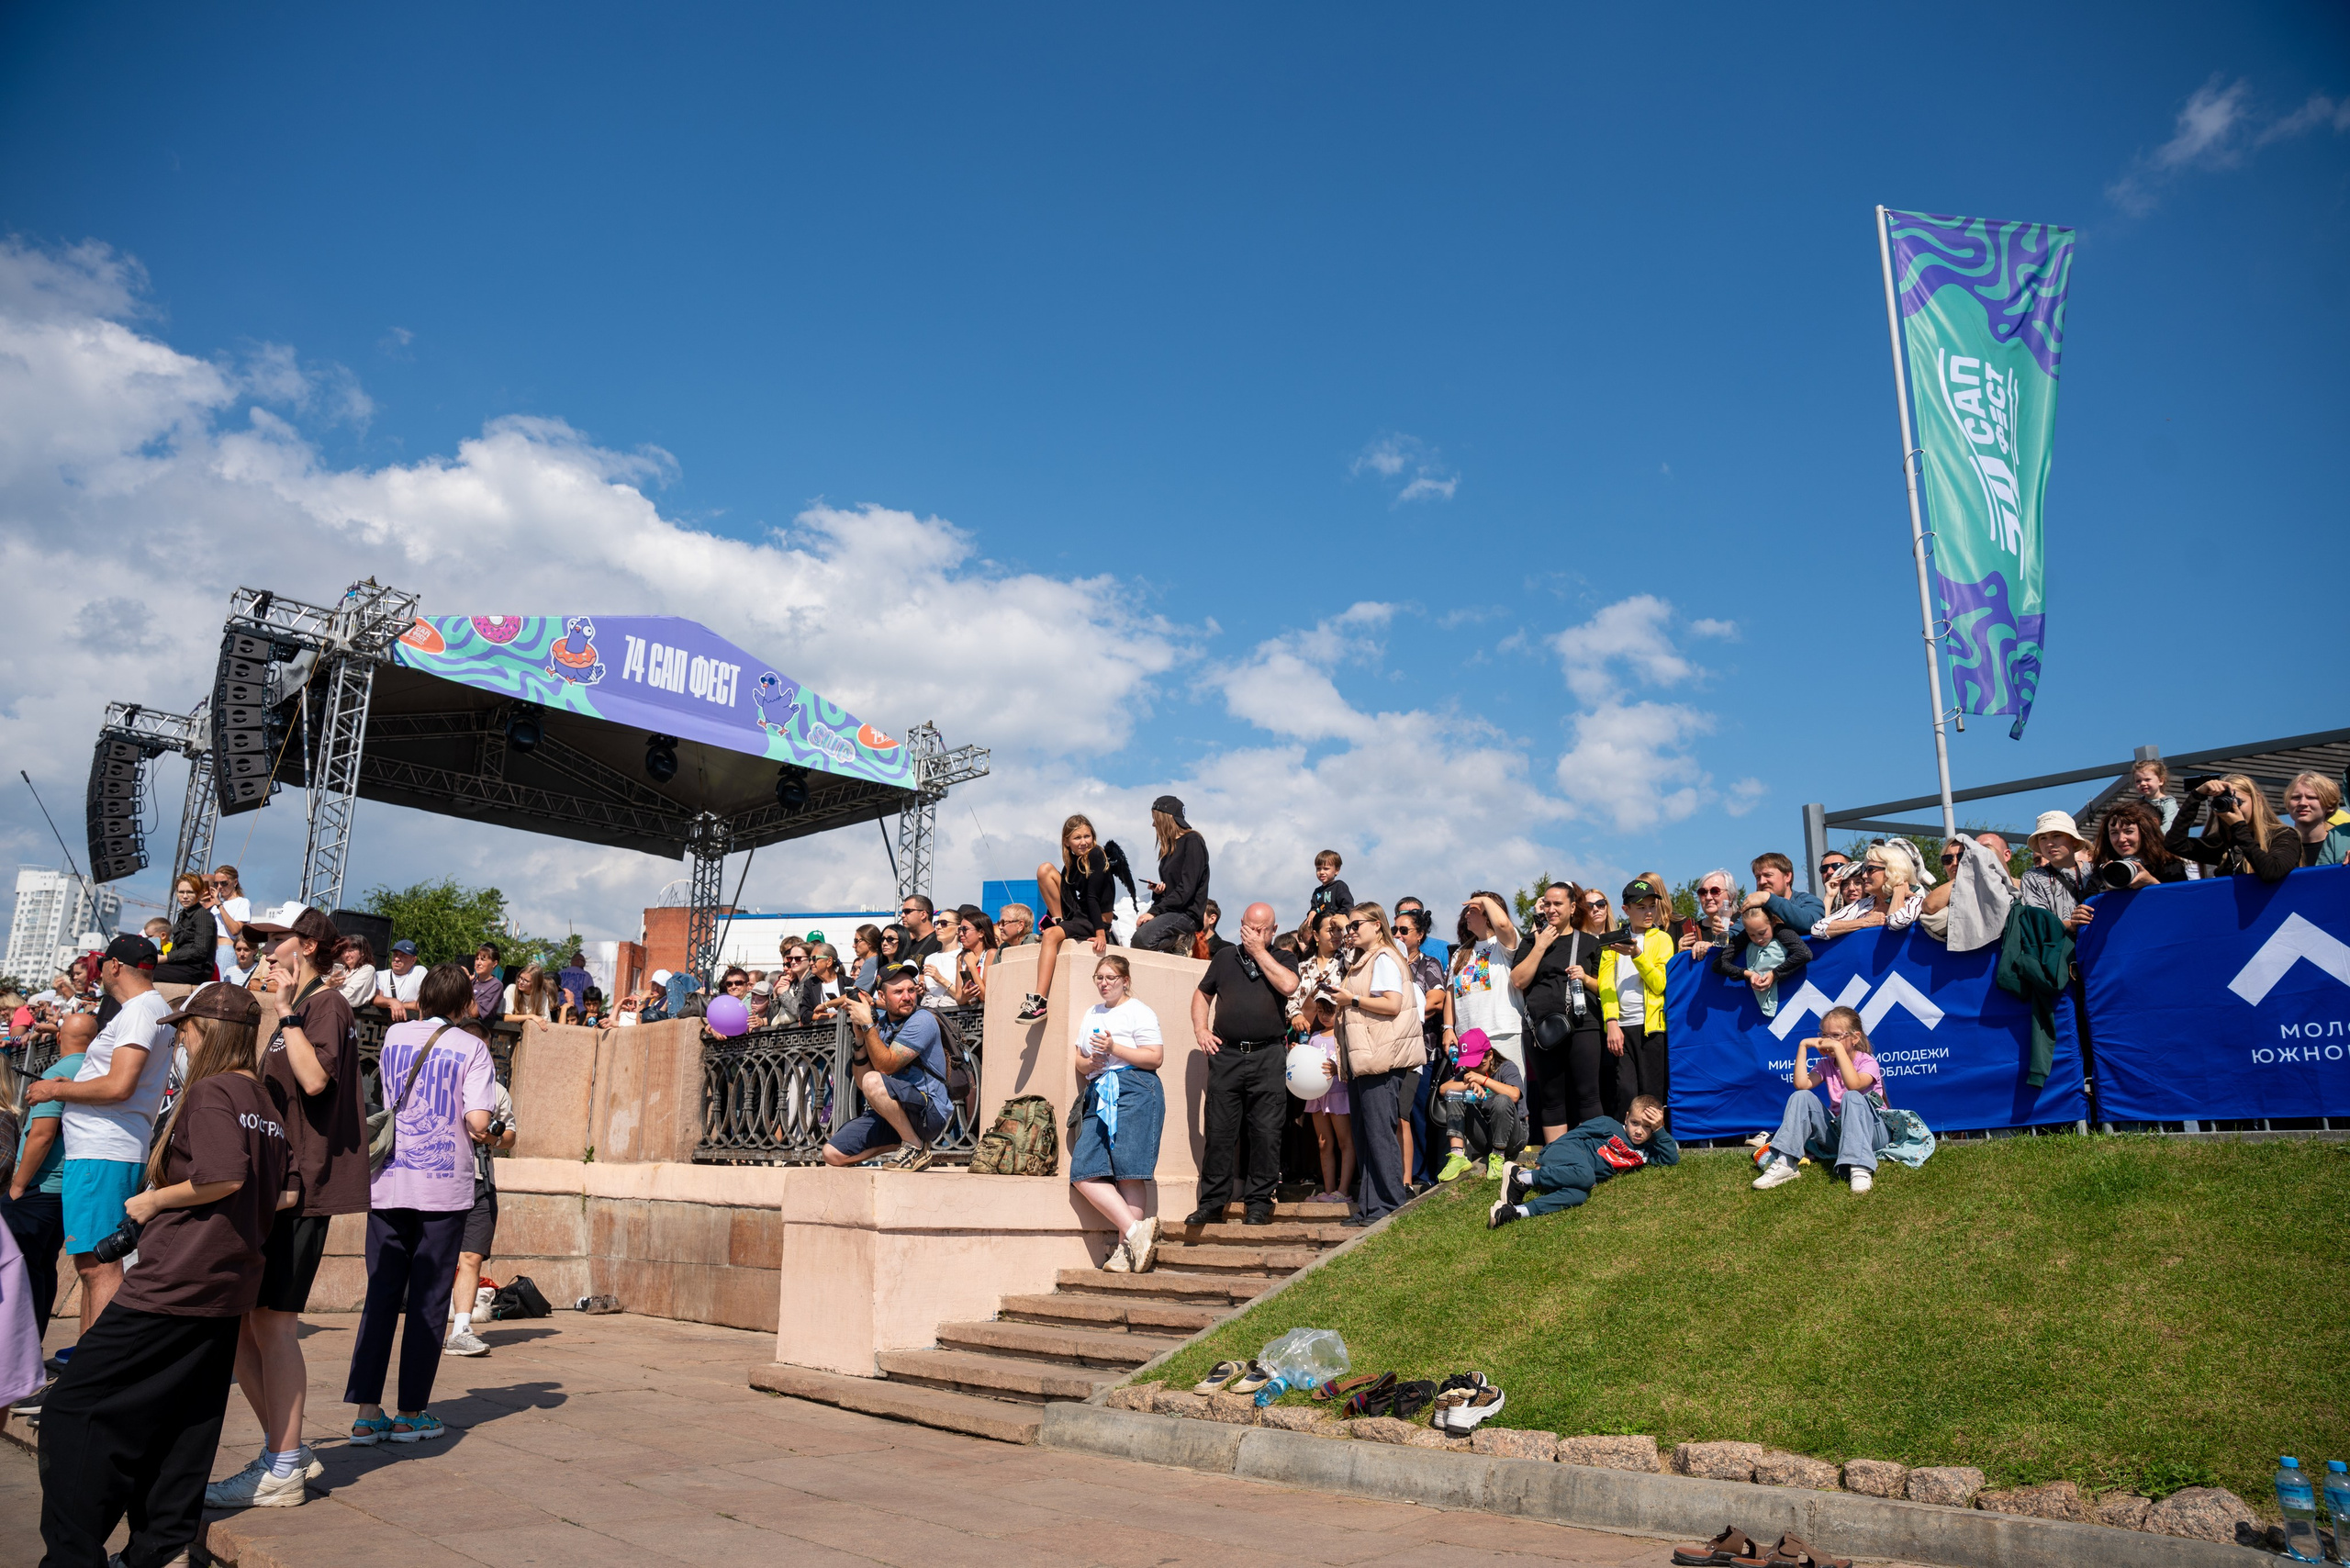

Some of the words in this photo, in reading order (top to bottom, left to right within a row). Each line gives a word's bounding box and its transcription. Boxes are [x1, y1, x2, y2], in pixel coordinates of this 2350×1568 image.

[1950, 355, 1995, 445] САП
[622, 634, 646, 683] 74
[647, 643, 688, 694] САП
[688, 655, 741, 708] ФЕСТ
[2280, 1021, 2350, 1039] МОЛ
[1460, 1043, 1469, 1053] C
[2251, 1045, 2350, 1064] ЮЖНО
